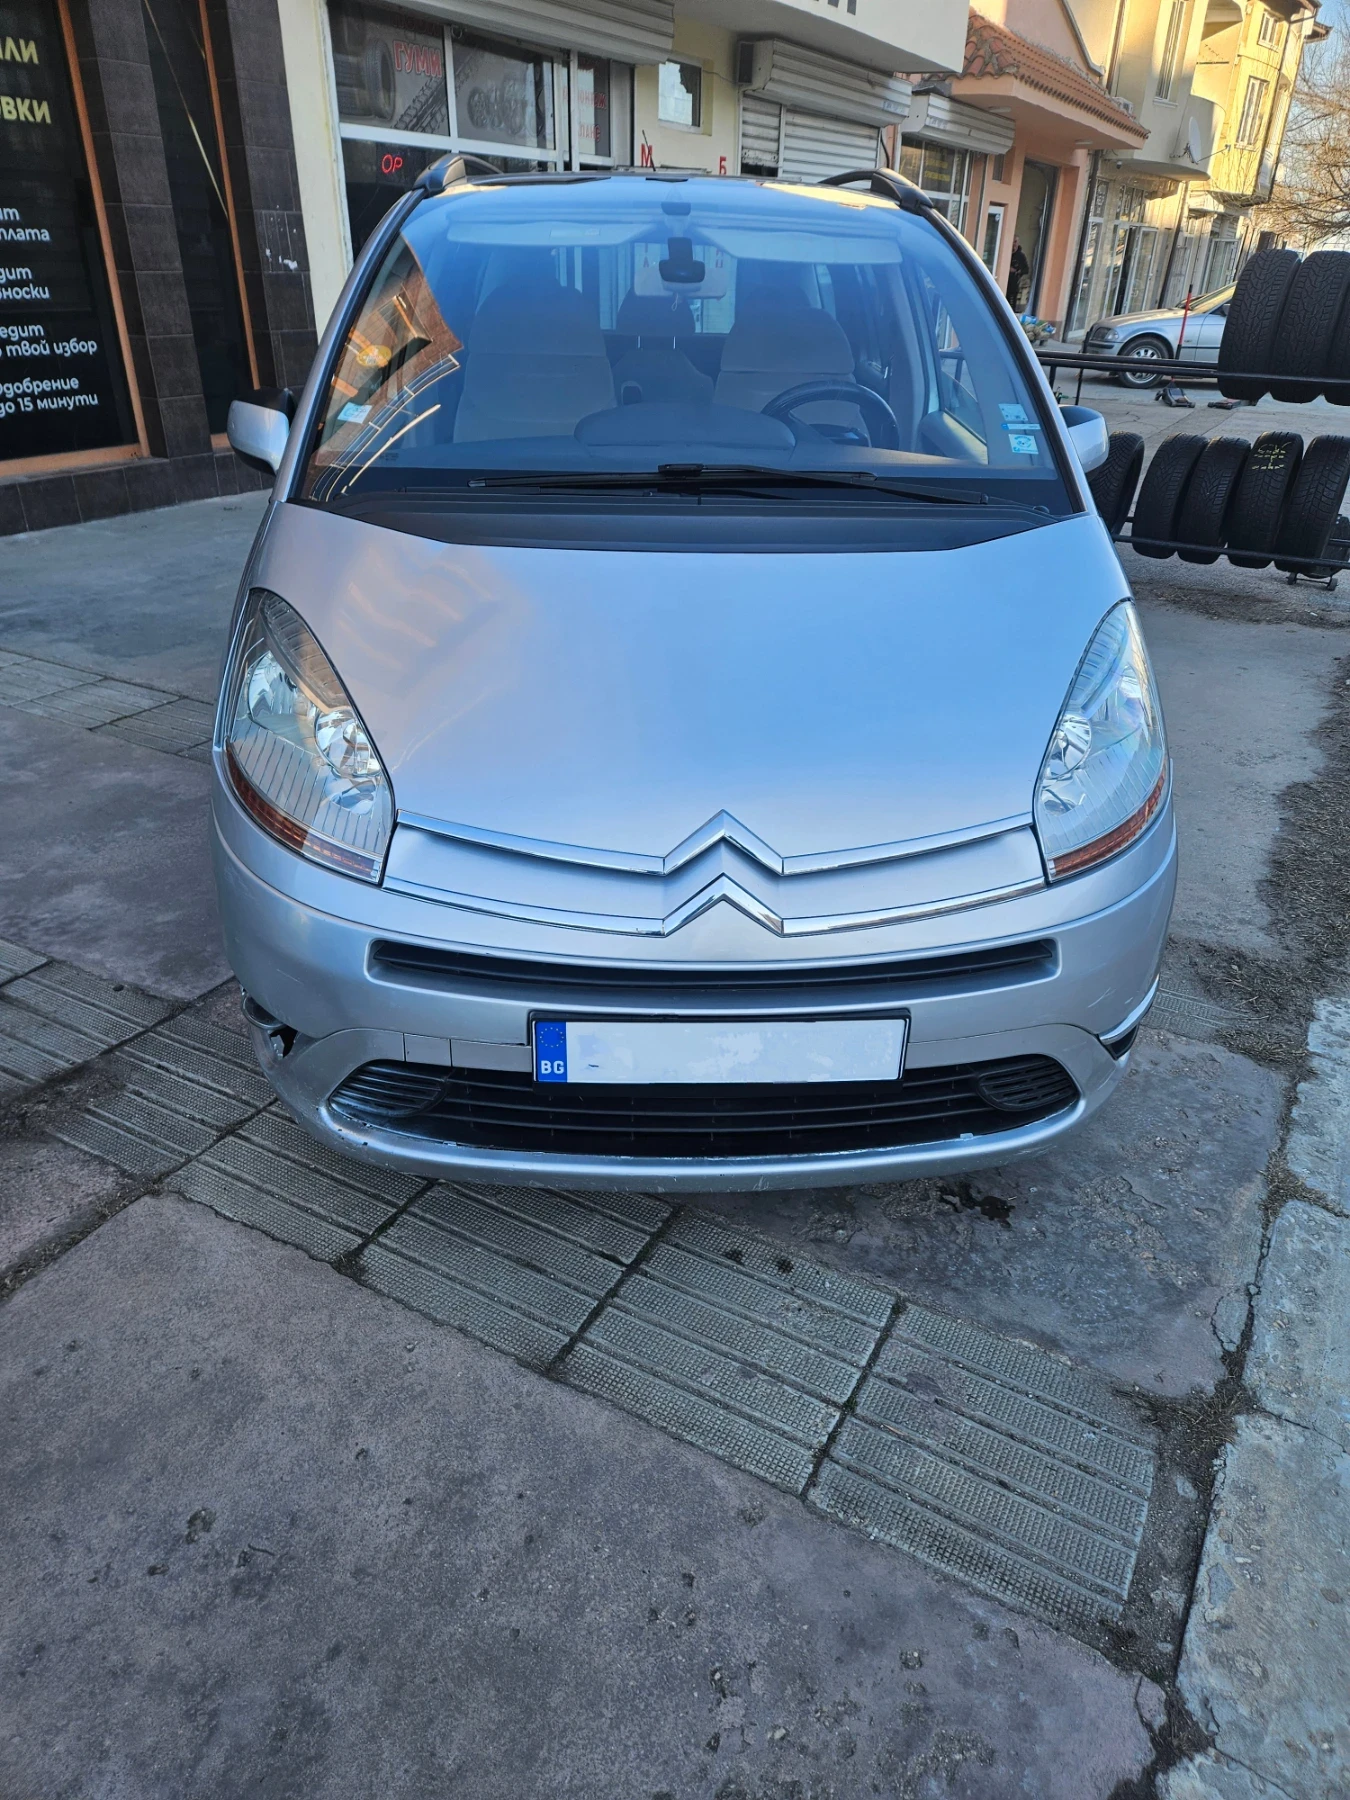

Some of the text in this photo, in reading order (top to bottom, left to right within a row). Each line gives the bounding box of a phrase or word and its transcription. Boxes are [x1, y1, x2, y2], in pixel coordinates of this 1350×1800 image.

[0, 36, 39, 65] ЛИ
[392, 40, 443, 78] ГУМИ
[0, 283, 50, 300] носки
[6, 338, 98, 357] твой избор
[17, 396, 33, 412] 15
[36, 393, 99, 411] минути
[540, 1060, 565, 1075] BG
